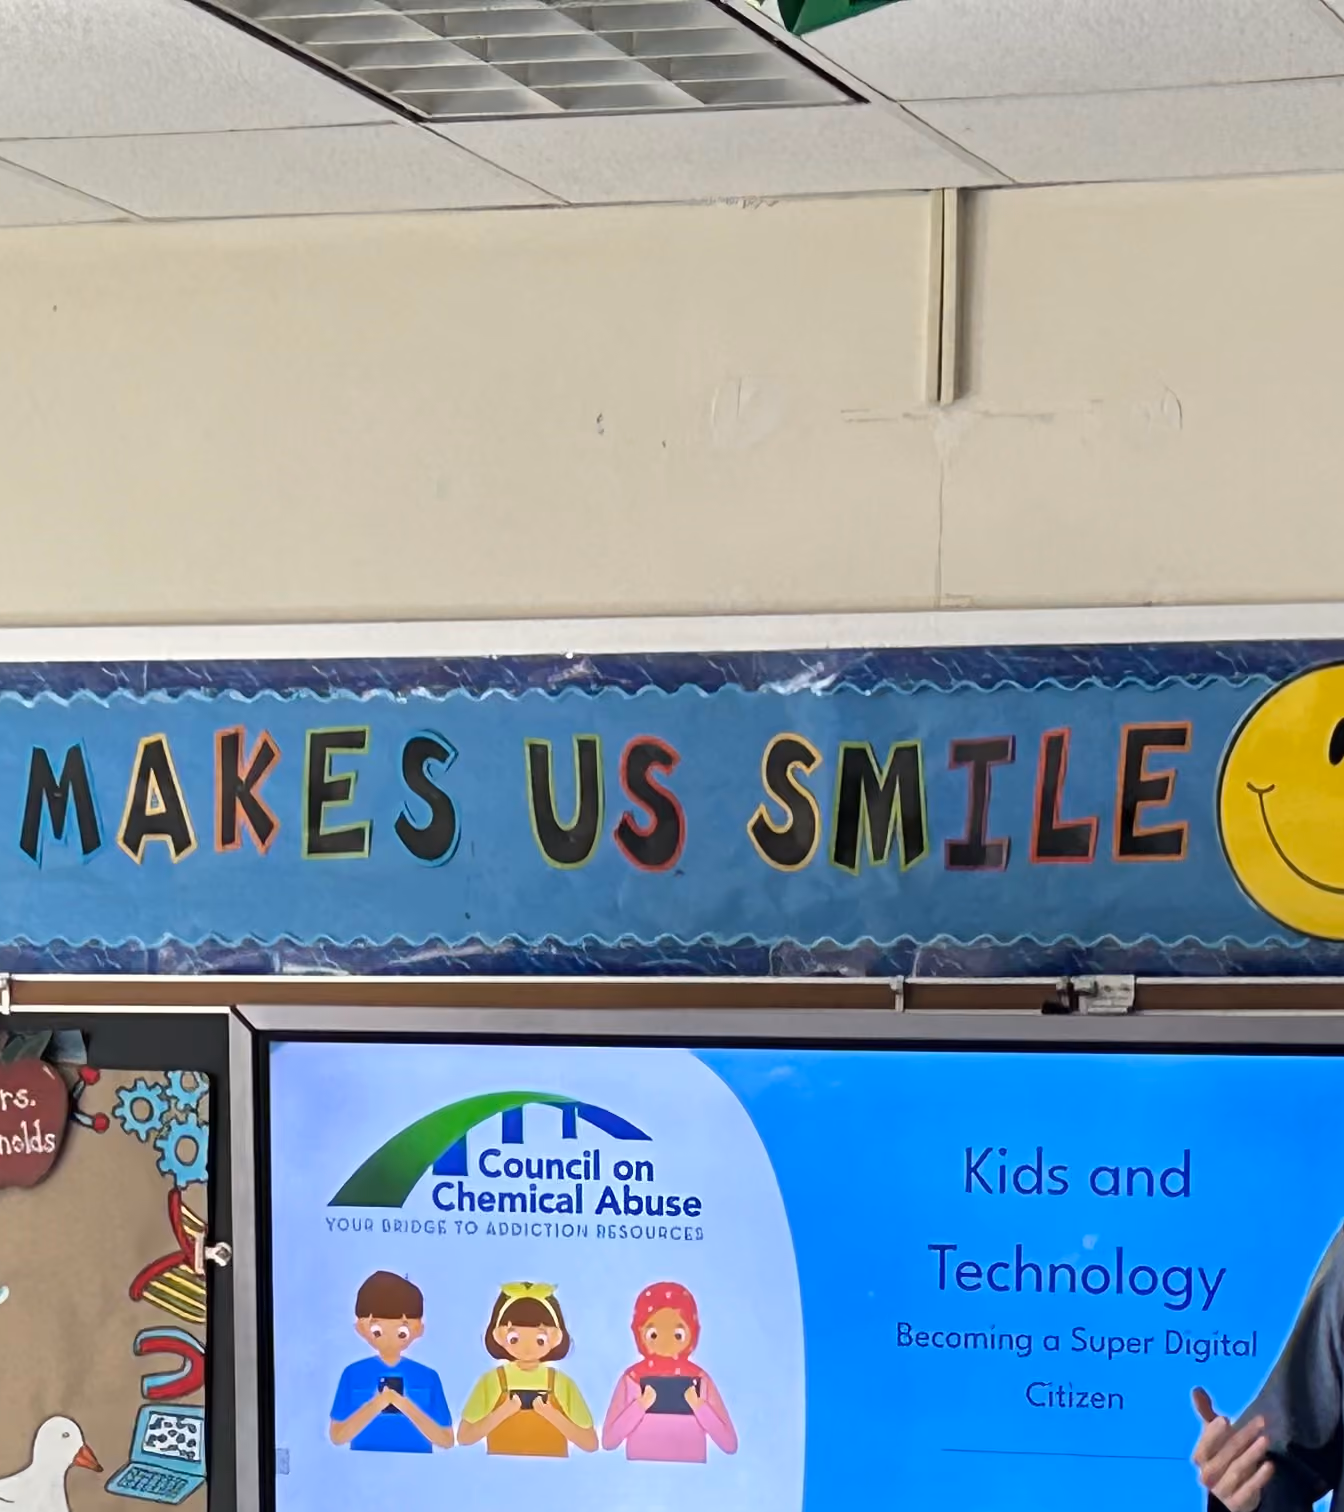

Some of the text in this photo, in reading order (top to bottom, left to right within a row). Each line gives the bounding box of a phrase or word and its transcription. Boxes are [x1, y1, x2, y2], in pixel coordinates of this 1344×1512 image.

[18, 723, 460, 868] MAKES
[523, 734, 685, 872] US
[748, 721, 1192, 874] SMILE
[478, 1149, 654, 1182] Council on
[964, 1146, 1191, 1198] Kids and
[432, 1181, 702, 1217] Chemical Abuse
[325, 1216, 704, 1241] YOUR BRIDGE TO ADDICTION RESOURCES
[927, 1243, 1226, 1311] Technology
[896, 1321, 1257, 1363] Becoming a Super Digital
[1025, 1381, 1124, 1410] Citizen
